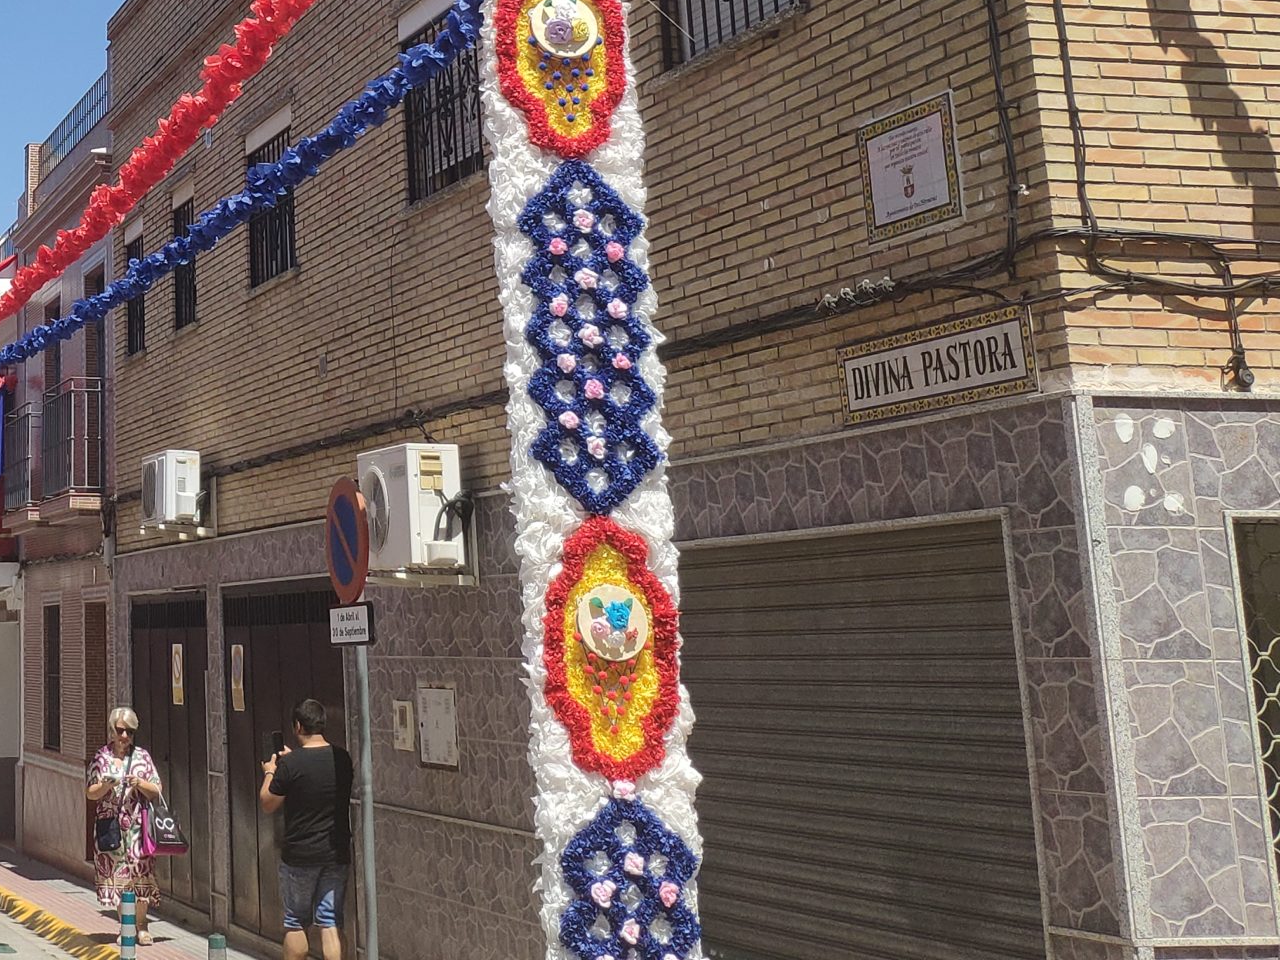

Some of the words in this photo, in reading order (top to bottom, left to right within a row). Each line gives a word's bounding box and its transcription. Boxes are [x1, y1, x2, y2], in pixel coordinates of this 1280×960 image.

[852, 356, 914, 400] DIVINA
[921, 332, 1018, 387] PASTORA
[345, 611, 355, 621] Abril
[344, 625, 366, 639] Septiembre
